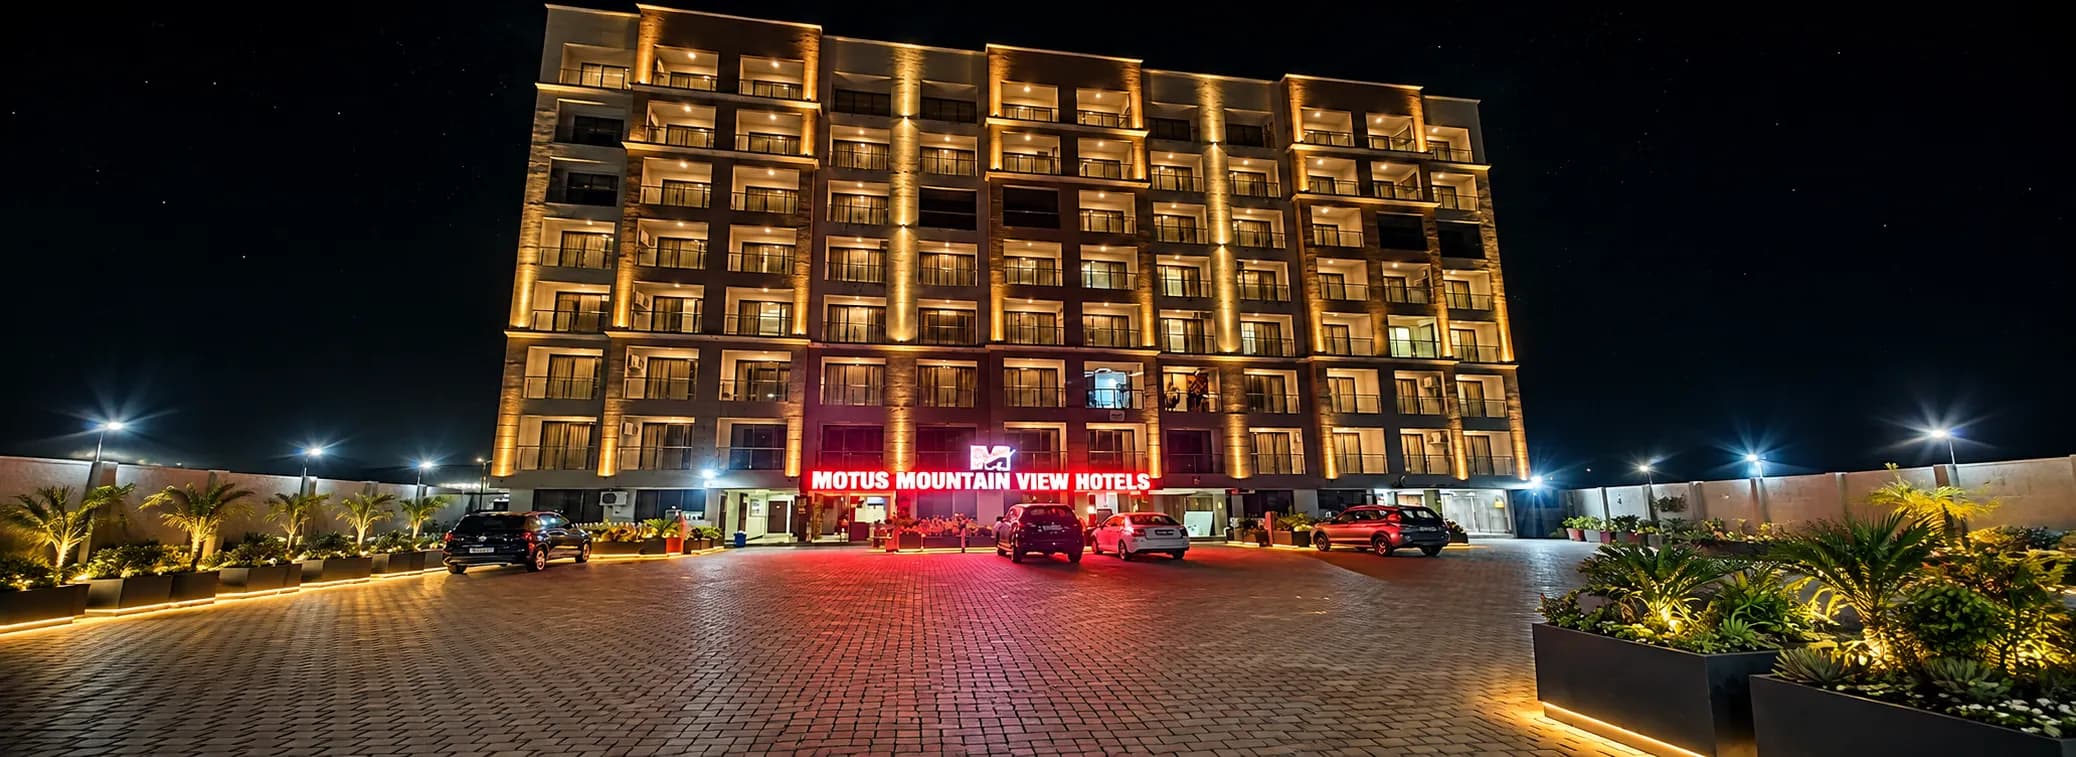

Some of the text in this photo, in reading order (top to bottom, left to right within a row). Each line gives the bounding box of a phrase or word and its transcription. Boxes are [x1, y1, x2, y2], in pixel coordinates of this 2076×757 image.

[811, 470, 1151, 491] MOTUS MOUNTAIN VIEW HOTELS
